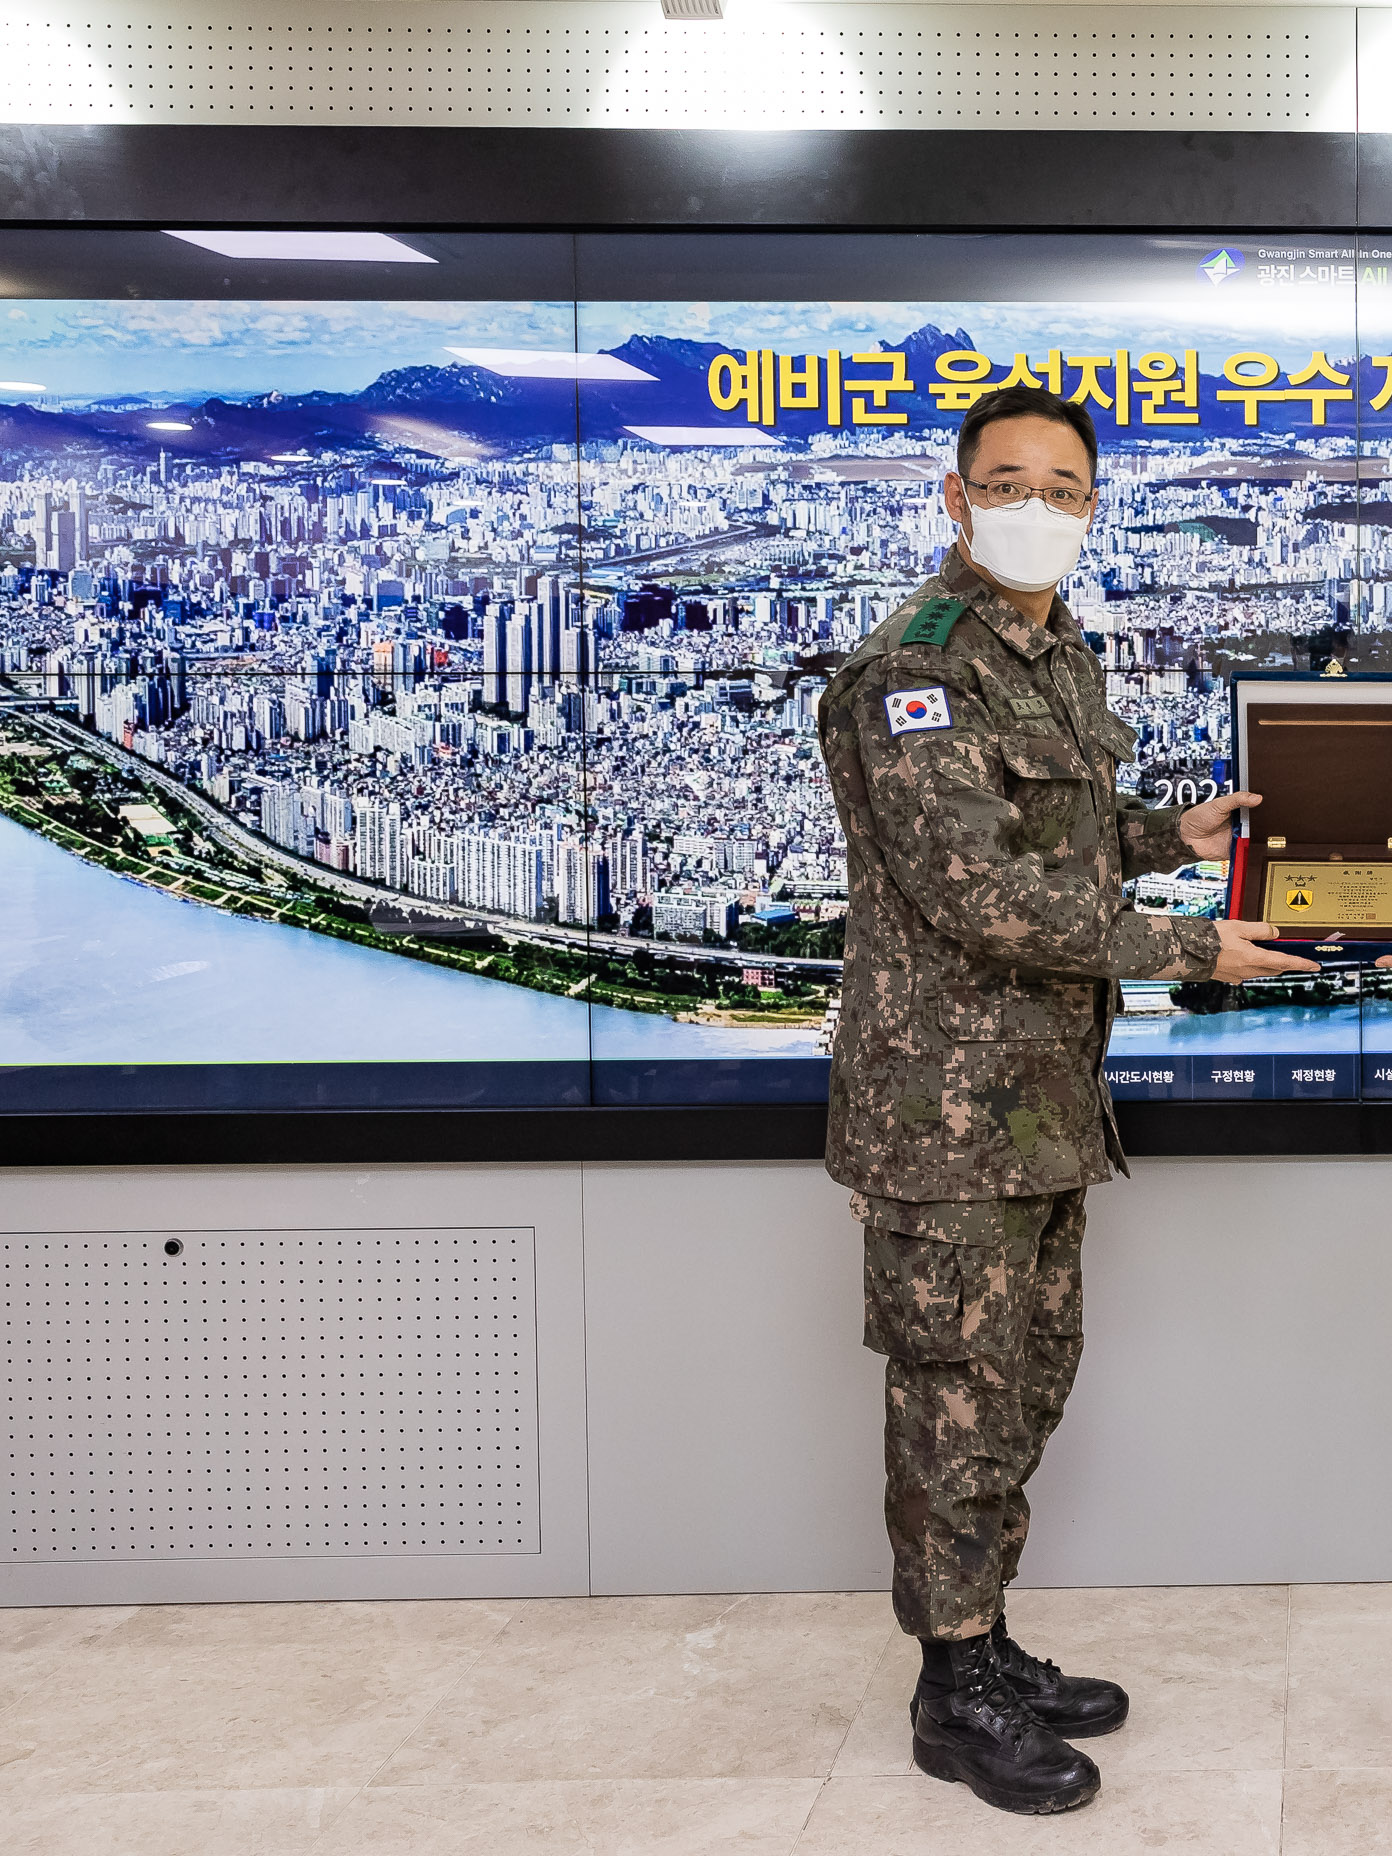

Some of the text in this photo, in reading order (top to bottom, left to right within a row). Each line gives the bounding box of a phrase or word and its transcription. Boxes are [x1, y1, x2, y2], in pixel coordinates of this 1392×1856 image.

[1257, 248, 1306, 261] Gwangjin
[1308, 248, 1339, 259] Smart
[1340, 248, 1355, 259] All
[1358, 249, 1369, 259] In
[1371, 248, 1392, 259] One
[1256, 264, 1295, 287] 광진
[1298, 264, 1355, 286] 스마트
[1361, 266, 1389, 286] All
[708, 348, 915, 427] 예비군
[1216, 350, 1353, 426] 우수
[1104, 1070, 1174, 1084] 시간도시현황
[1210, 1069, 1256, 1084] 구정현황
[1291, 1068, 1337, 1083] 재정현황
